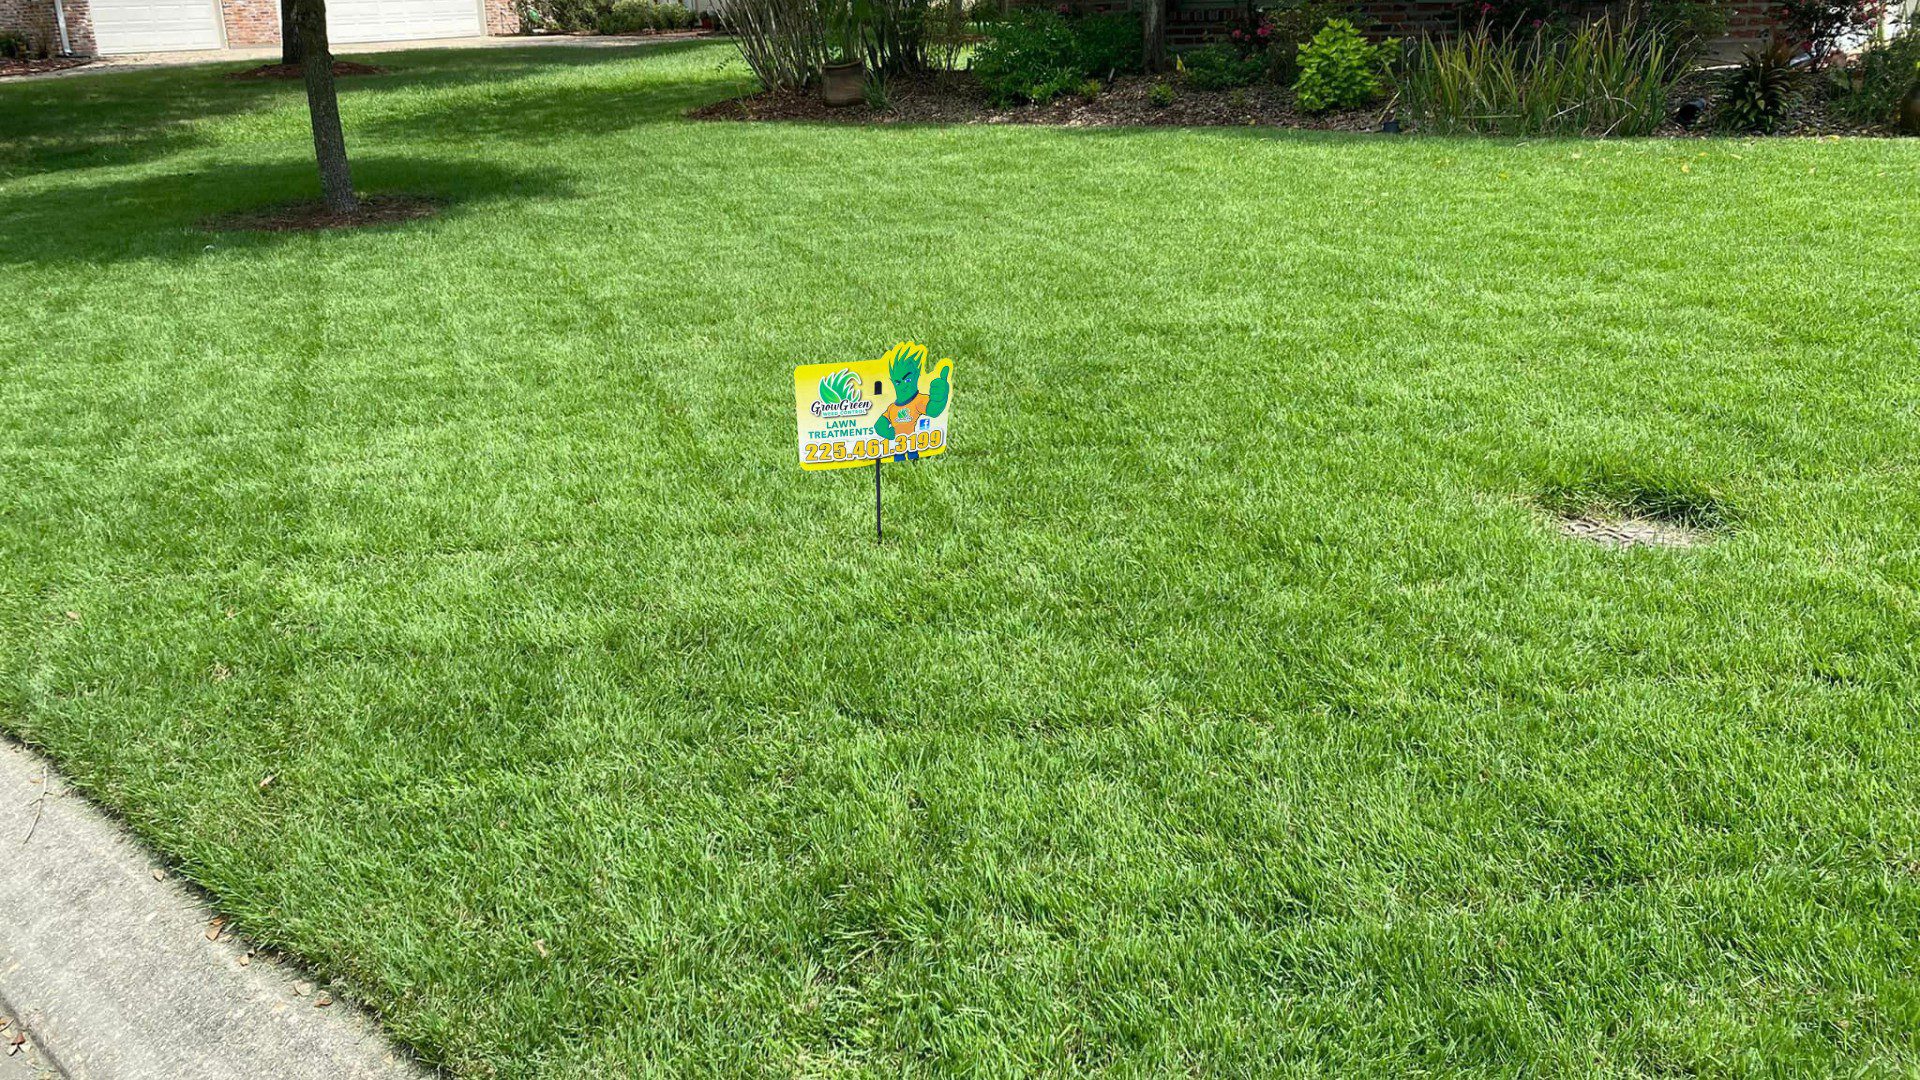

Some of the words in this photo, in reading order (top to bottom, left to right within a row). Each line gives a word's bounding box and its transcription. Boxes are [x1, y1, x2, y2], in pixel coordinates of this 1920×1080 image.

[811, 400, 870, 415] GrowGreen
[826, 419, 857, 429] LAWN
[808, 426, 874, 439] TREATMENTS
[805, 429, 942, 462] 225.461.3199
